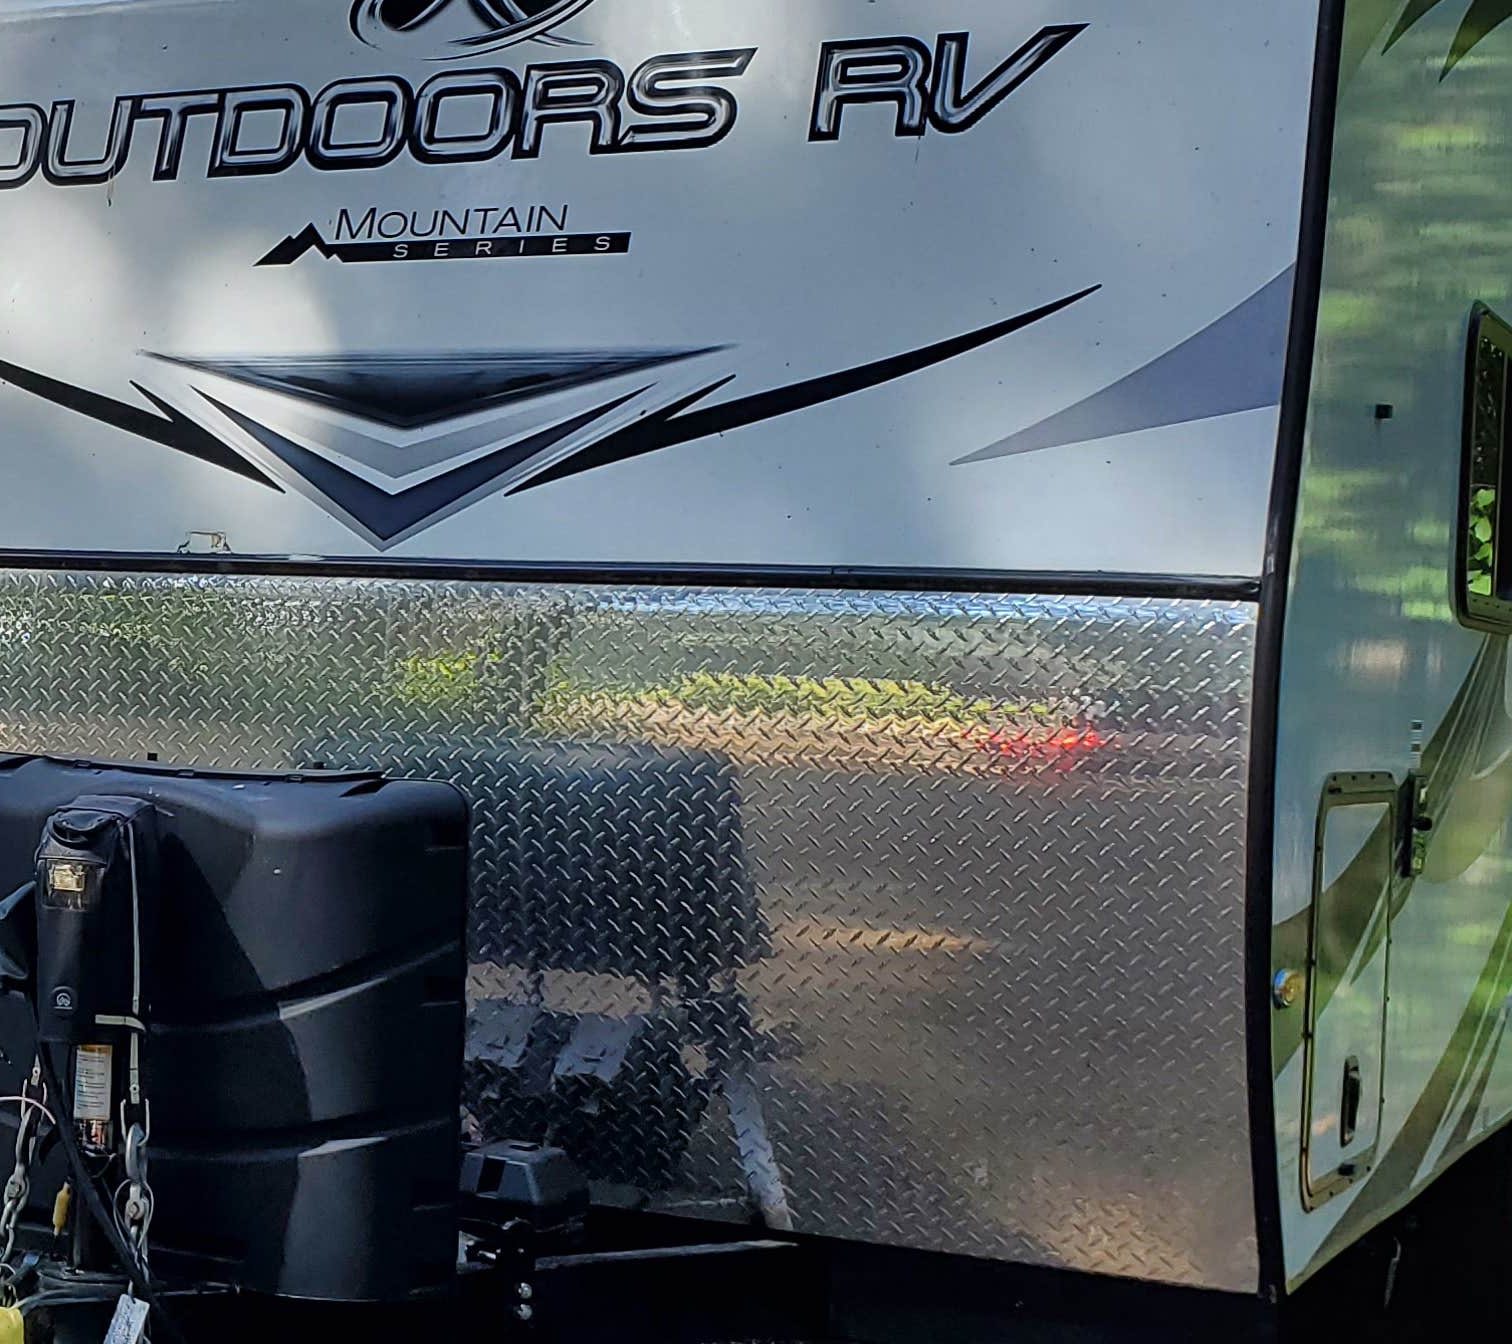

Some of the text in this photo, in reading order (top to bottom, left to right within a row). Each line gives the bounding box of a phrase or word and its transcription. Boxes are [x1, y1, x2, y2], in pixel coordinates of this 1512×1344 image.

[808, 23, 1090, 142] RV
[335, 204, 568, 240] MOUNTAIN
[393, 236, 611, 258] SERIES
